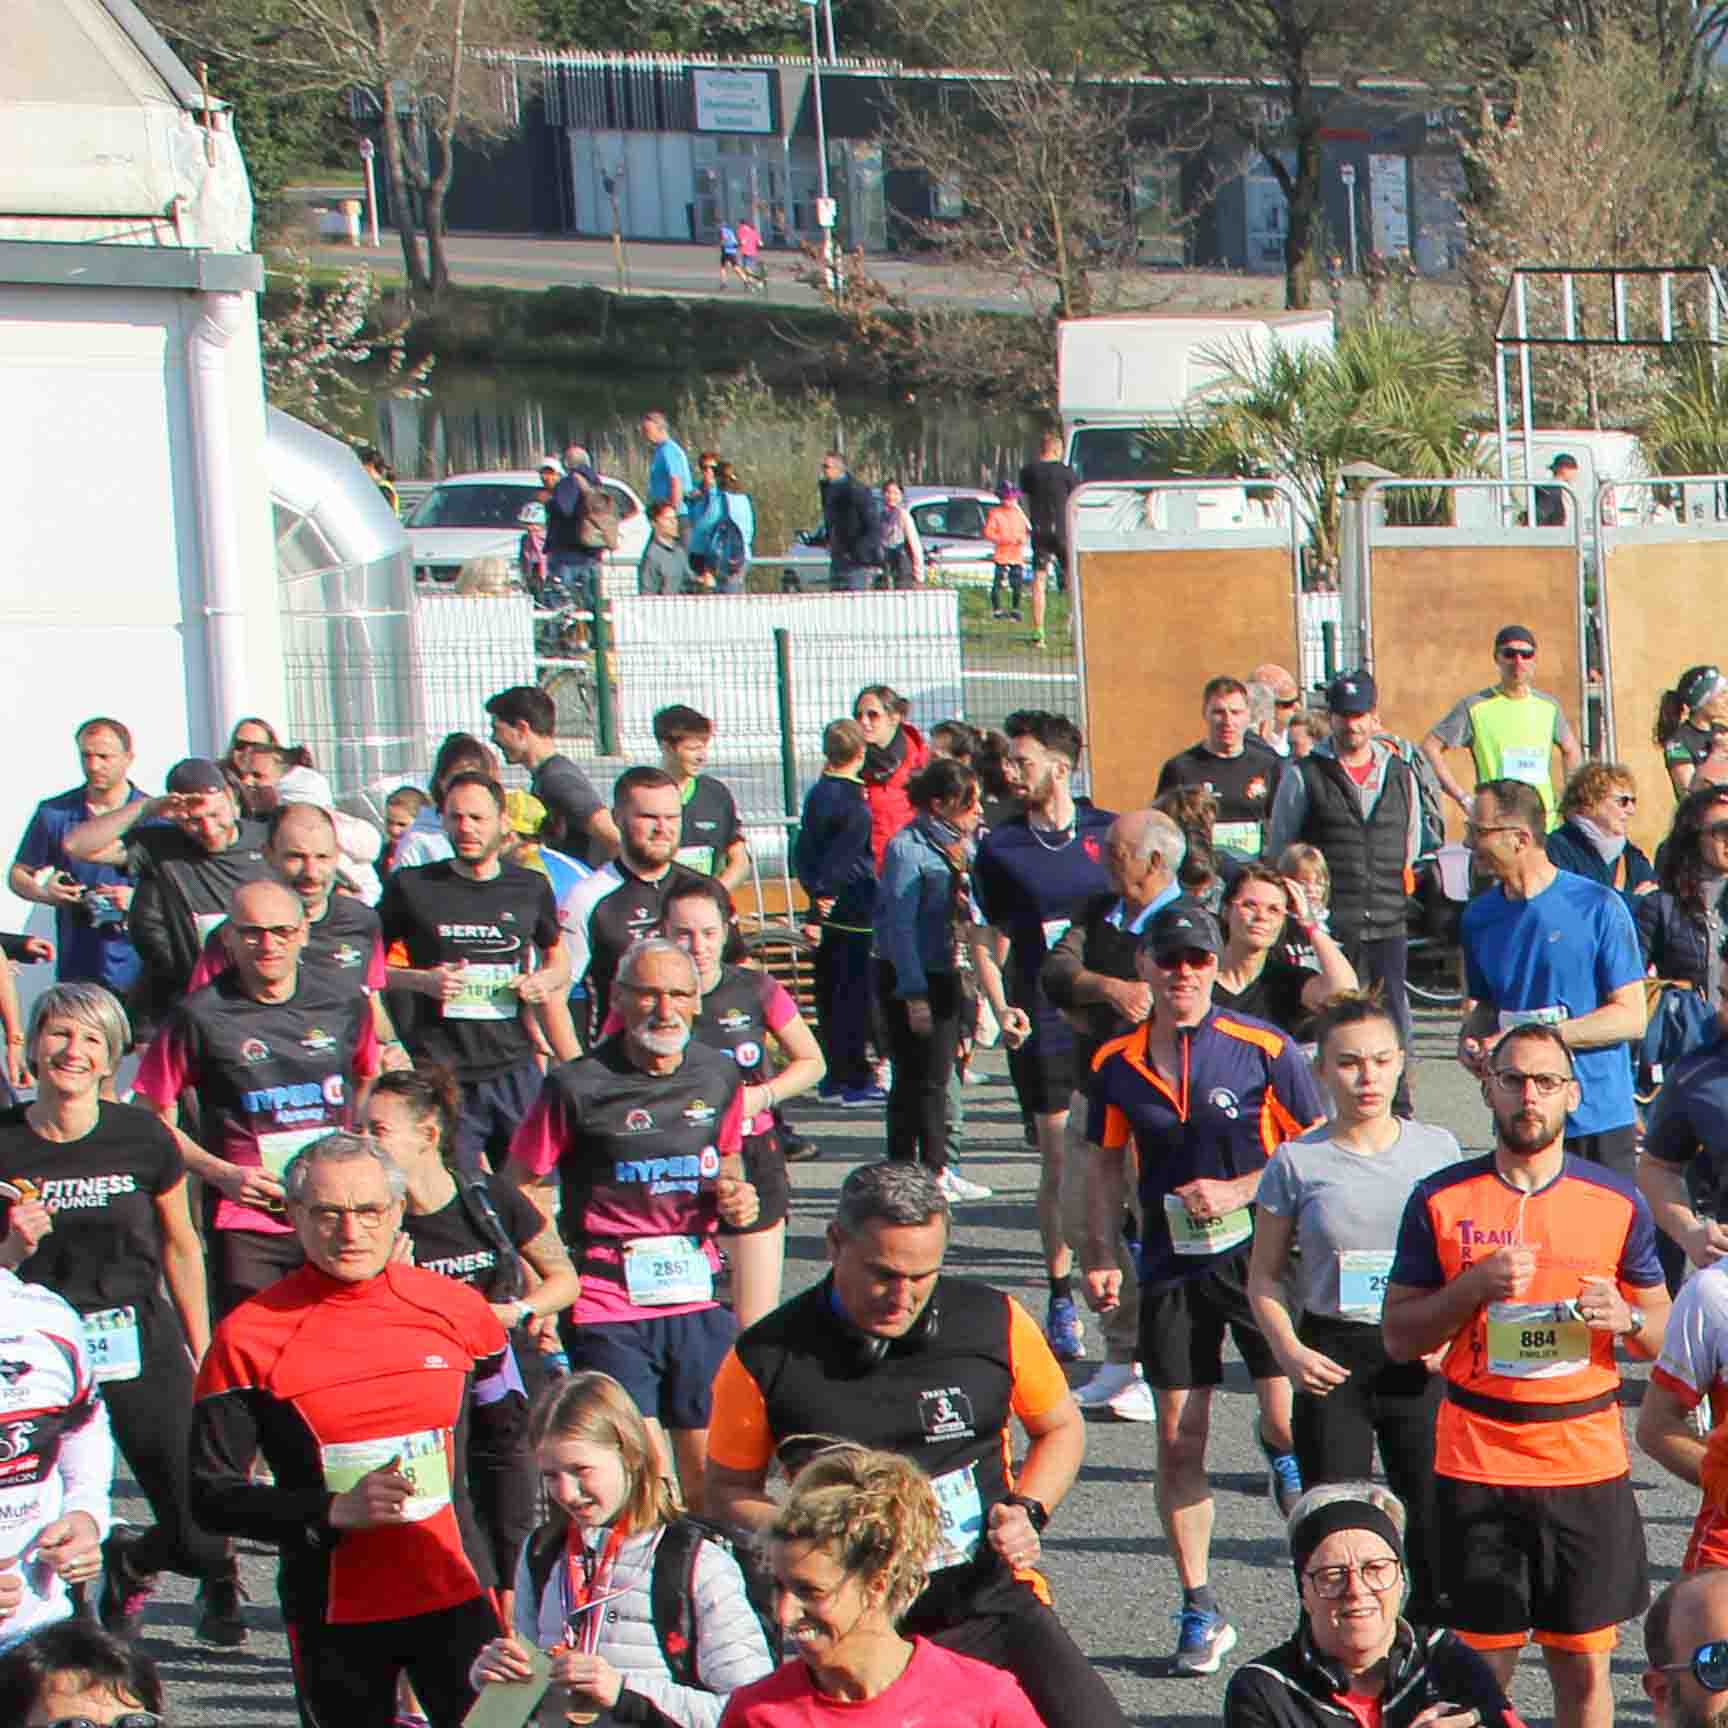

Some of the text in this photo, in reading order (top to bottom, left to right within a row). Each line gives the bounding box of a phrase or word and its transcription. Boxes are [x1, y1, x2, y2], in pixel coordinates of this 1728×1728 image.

[438, 925, 503, 939] SERTA
[242, 1083, 322, 1111] HYPER
[616, 1155, 699, 1183] HYPER
[41, 1175, 136, 1198] FITNESS
[1519, 1326, 1556, 1347] 884
